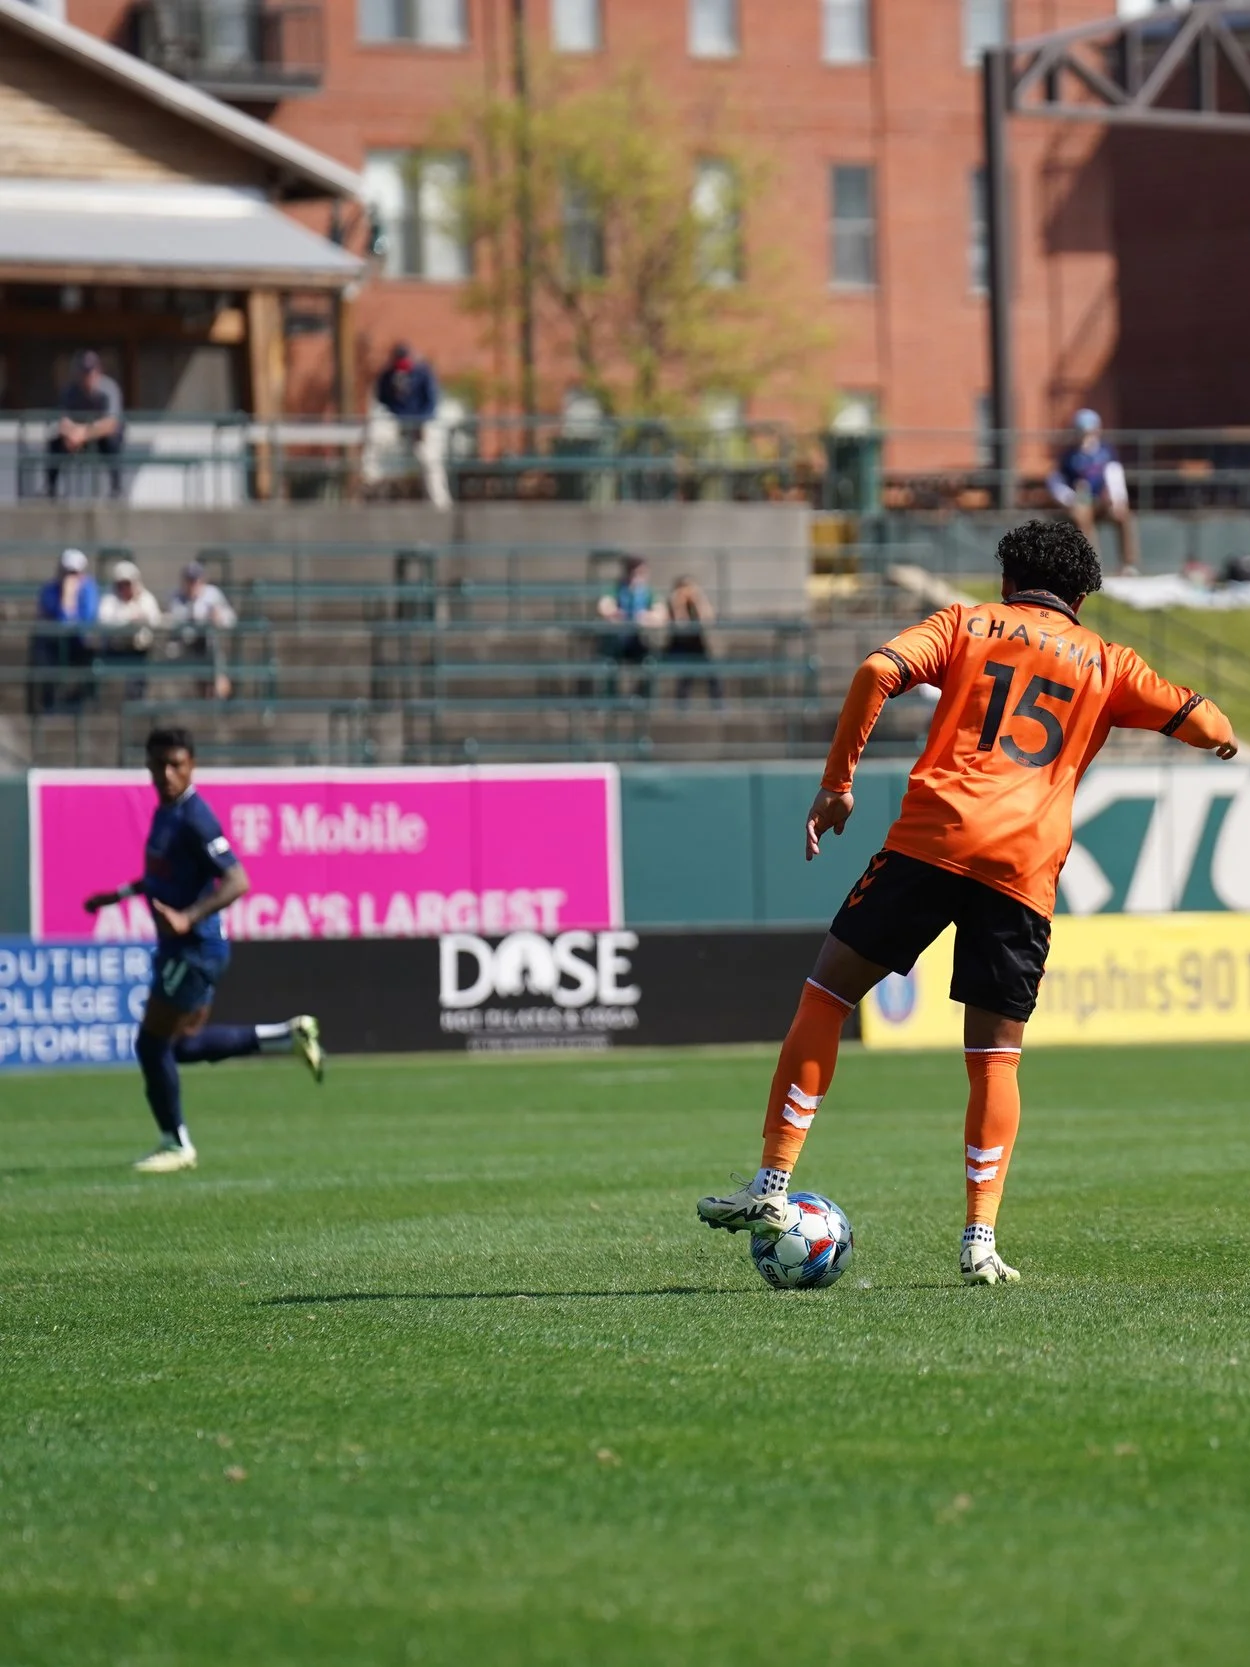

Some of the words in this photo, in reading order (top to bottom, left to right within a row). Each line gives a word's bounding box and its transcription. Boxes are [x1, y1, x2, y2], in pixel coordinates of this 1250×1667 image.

[977, 661, 1075, 768] 15
[231, 803, 272, 856] T
[280, 800, 428, 854] Mobile
[92, 892, 352, 942] AMICA'S
[359, 887, 567, 939] LARGEST
[0, 947, 152, 988] OUTHER
[0, 985, 121, 1027] OLLEGE
[0, 1022, 138, 1063] PTOMET
